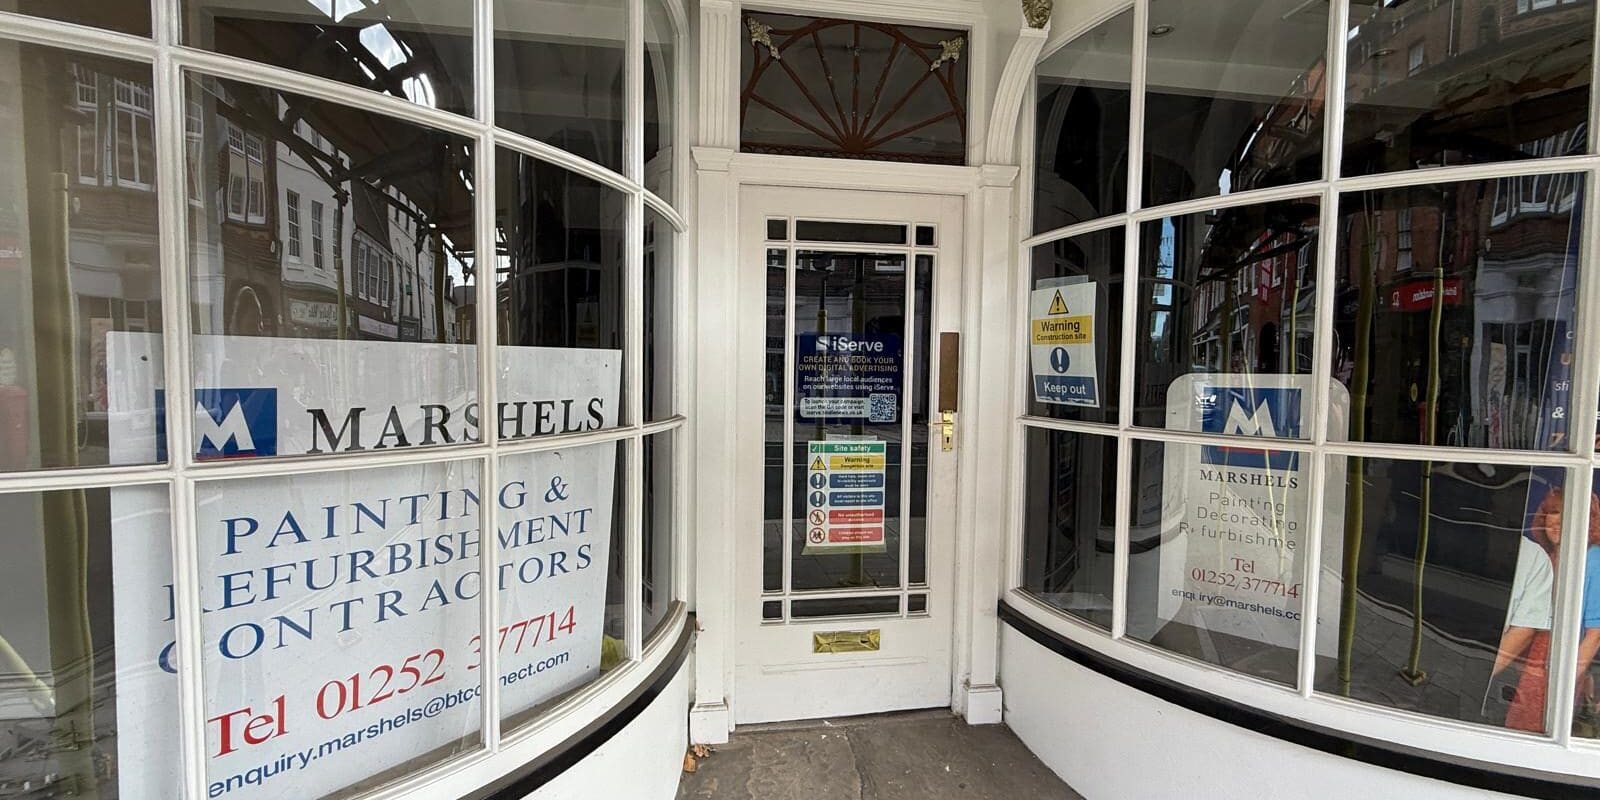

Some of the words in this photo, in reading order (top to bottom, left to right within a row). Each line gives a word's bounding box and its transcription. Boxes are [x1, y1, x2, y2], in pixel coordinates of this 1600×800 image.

[1041, 320, 1080, 333] Warning
[833, 336, 883, 352] iServe
[1036, 333, 1073, 341] Construction
[818, 364, 847, 372] DIGITAL
[849, 364, 898, 372] ADVERTISING
[804, 375, 825, 383] Reach
[1043, 381, 1067, 395] Keep
[1070, 384, 1086, 395] out
[306, 397, 605, 455] MARSHELS
[834, 443, 848, 451] Site
[849, 443, 871, 452] safety
[1200, 469, 1298, 489] MARSHELS
[219, 480, 528, 557] PAINTING
[544, 475, 570, 503] &
[1231, 557, 1256, 574] Tel
[207, 694, 290, 759] Tel
[316, 648, 447, 720] 01252
[208, 651, 569, 799] enquiry.marshels@btconect.com
